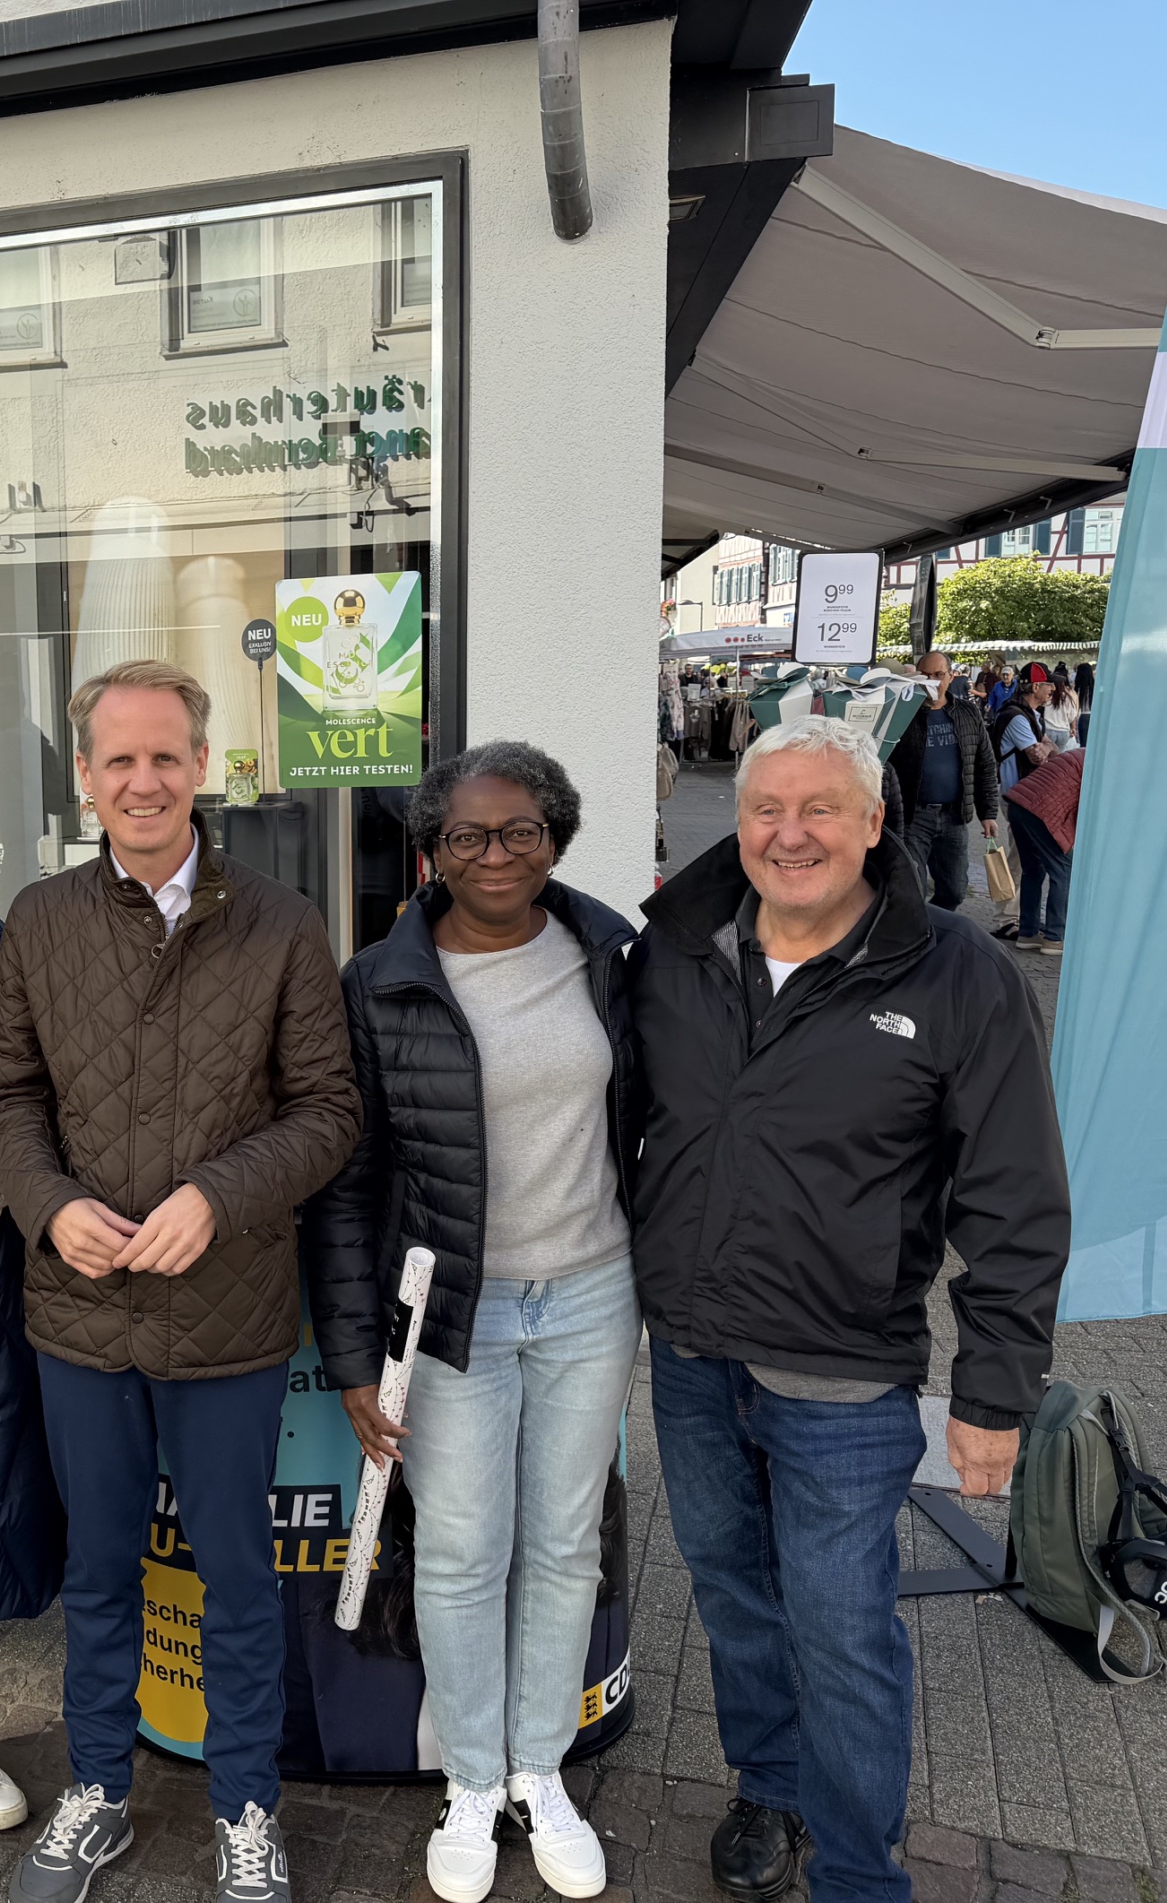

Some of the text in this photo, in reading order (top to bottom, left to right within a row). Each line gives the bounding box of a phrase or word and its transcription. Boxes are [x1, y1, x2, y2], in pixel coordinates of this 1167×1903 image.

[291, 613, 322, 626] NEU
[247, 627, 272, 640] NEU
[746, 633, 764, 642] Eck
[325, 717, 376, 726] MOLESCENCE
[306, 725, 394, 759] vert
[289, 763, 413, 776] JETZT HIER TESTEN!
[869, 1013, 901, 1029] NORTH
[885, 1011, 903, 1022] THE
[875, 1023, 899, 1035] FACE
[142, 1599, 202, 1629] scha
[141, 1652, 205, 1692] herhe
[604, 1663, 630, 1705] CD
